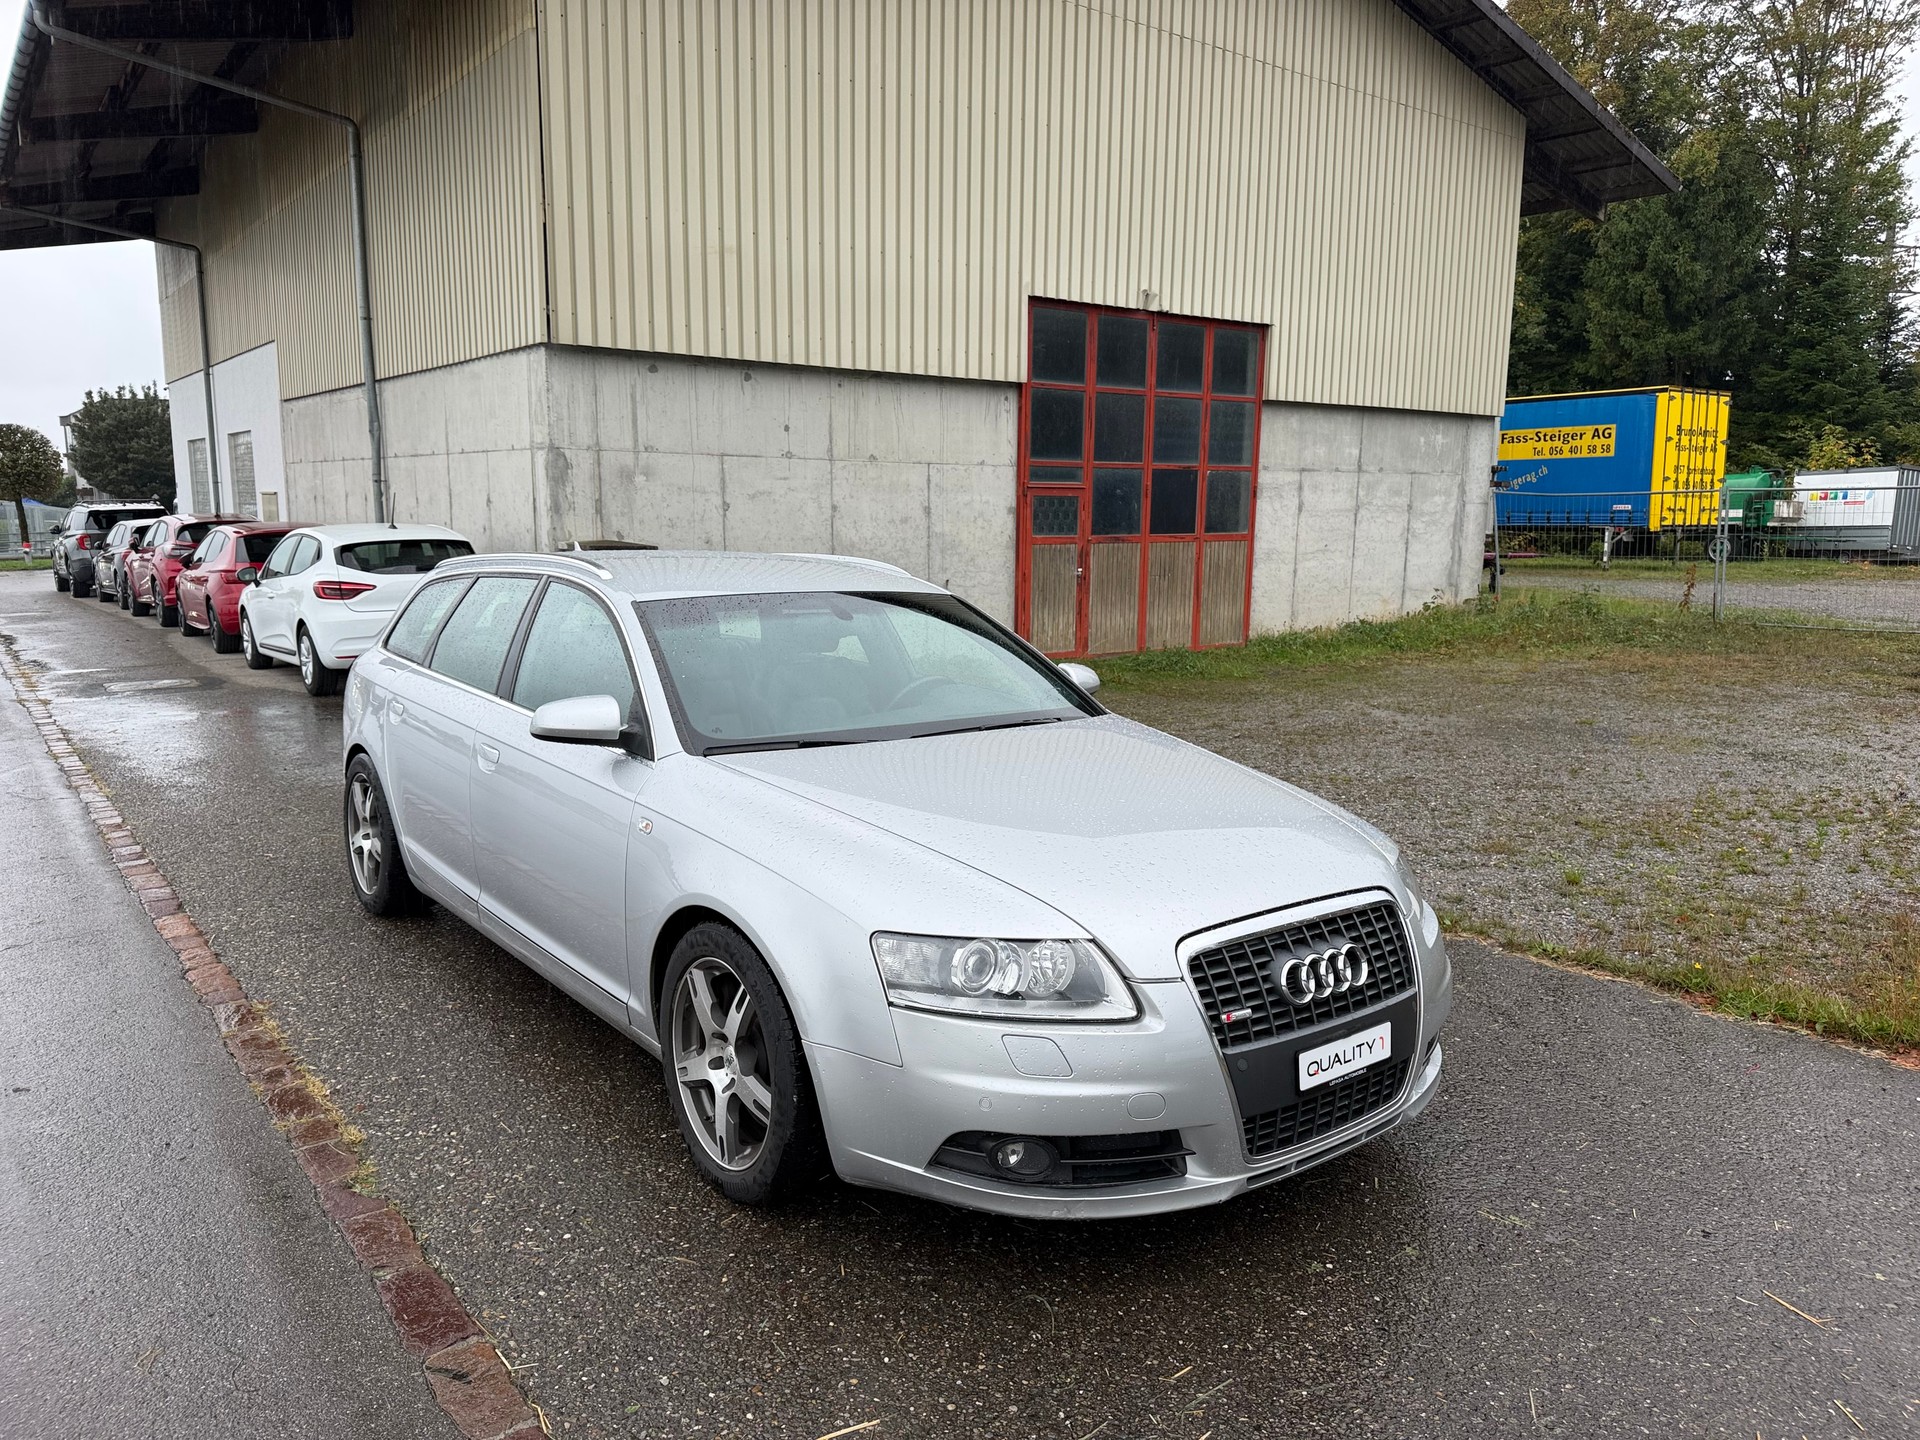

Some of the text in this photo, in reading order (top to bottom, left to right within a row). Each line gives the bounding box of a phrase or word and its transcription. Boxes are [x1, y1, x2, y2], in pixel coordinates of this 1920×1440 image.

[1501, 427, 1612, 445] Fass-Steiger AG
[1533, 444, 1611, 456] Tel. 056 401 58 58
[1307, 1036, 1385, 1077] QUALITY 1
